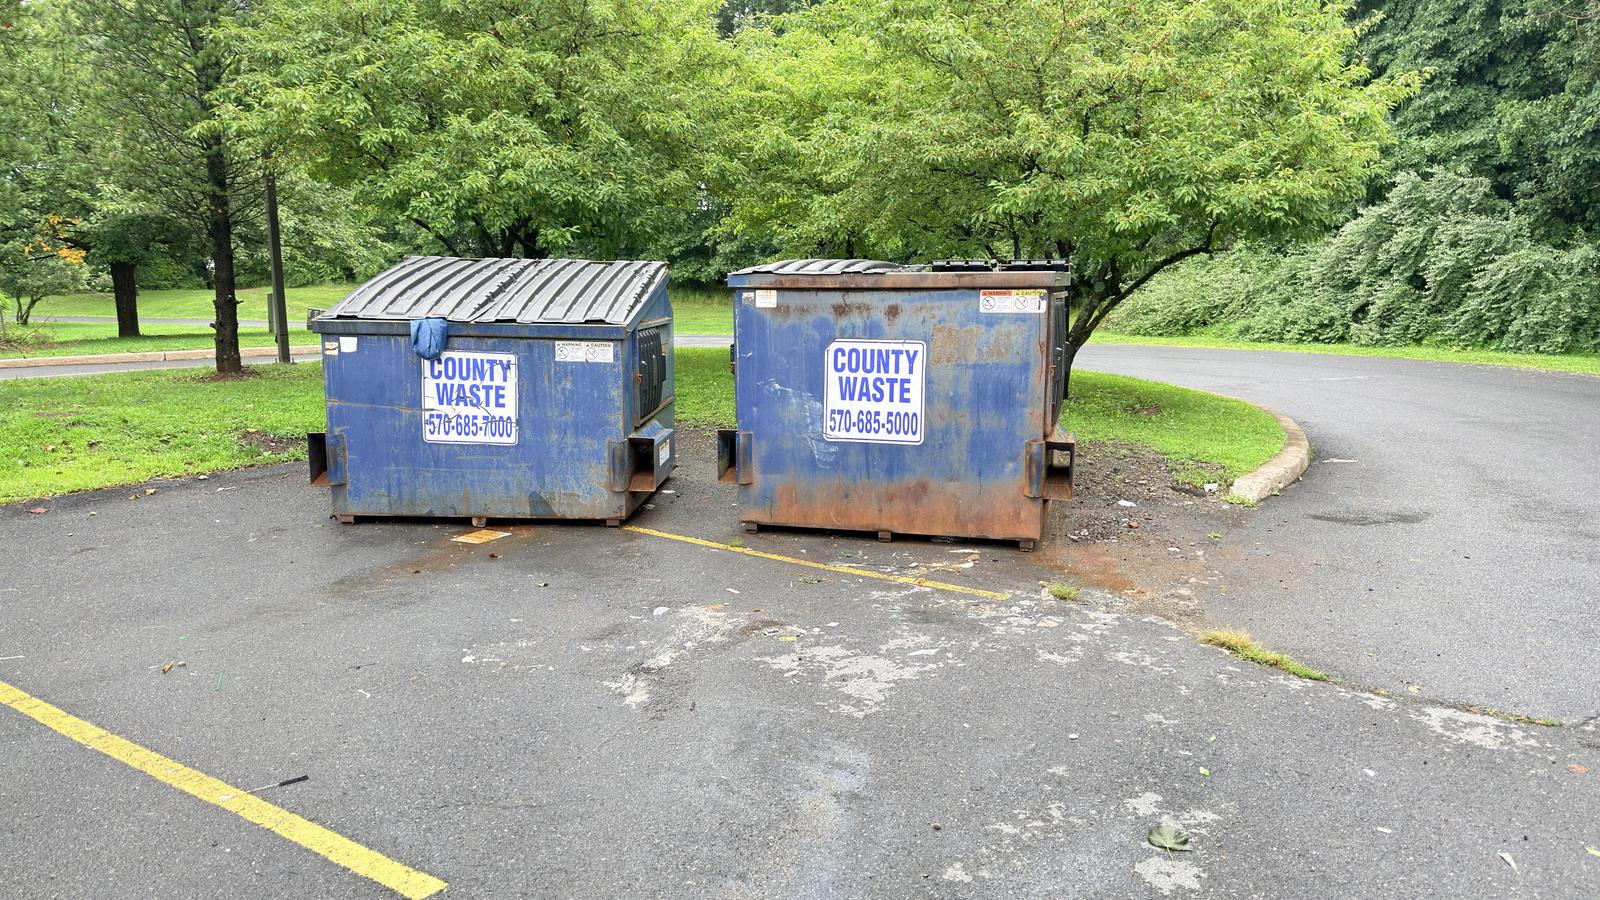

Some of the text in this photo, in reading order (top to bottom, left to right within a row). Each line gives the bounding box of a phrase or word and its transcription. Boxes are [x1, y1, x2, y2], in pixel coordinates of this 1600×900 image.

[429, 357, 511, 382] COUNTY
[833, 347, 919, 375] COUNTY
[435, 383, 506, 408] WASTE
[838, 376, 911, 403] WASTE
[428, 413, 513, 438] 570-685-7000
[829, 409, 918, 436] 570-685-5000
